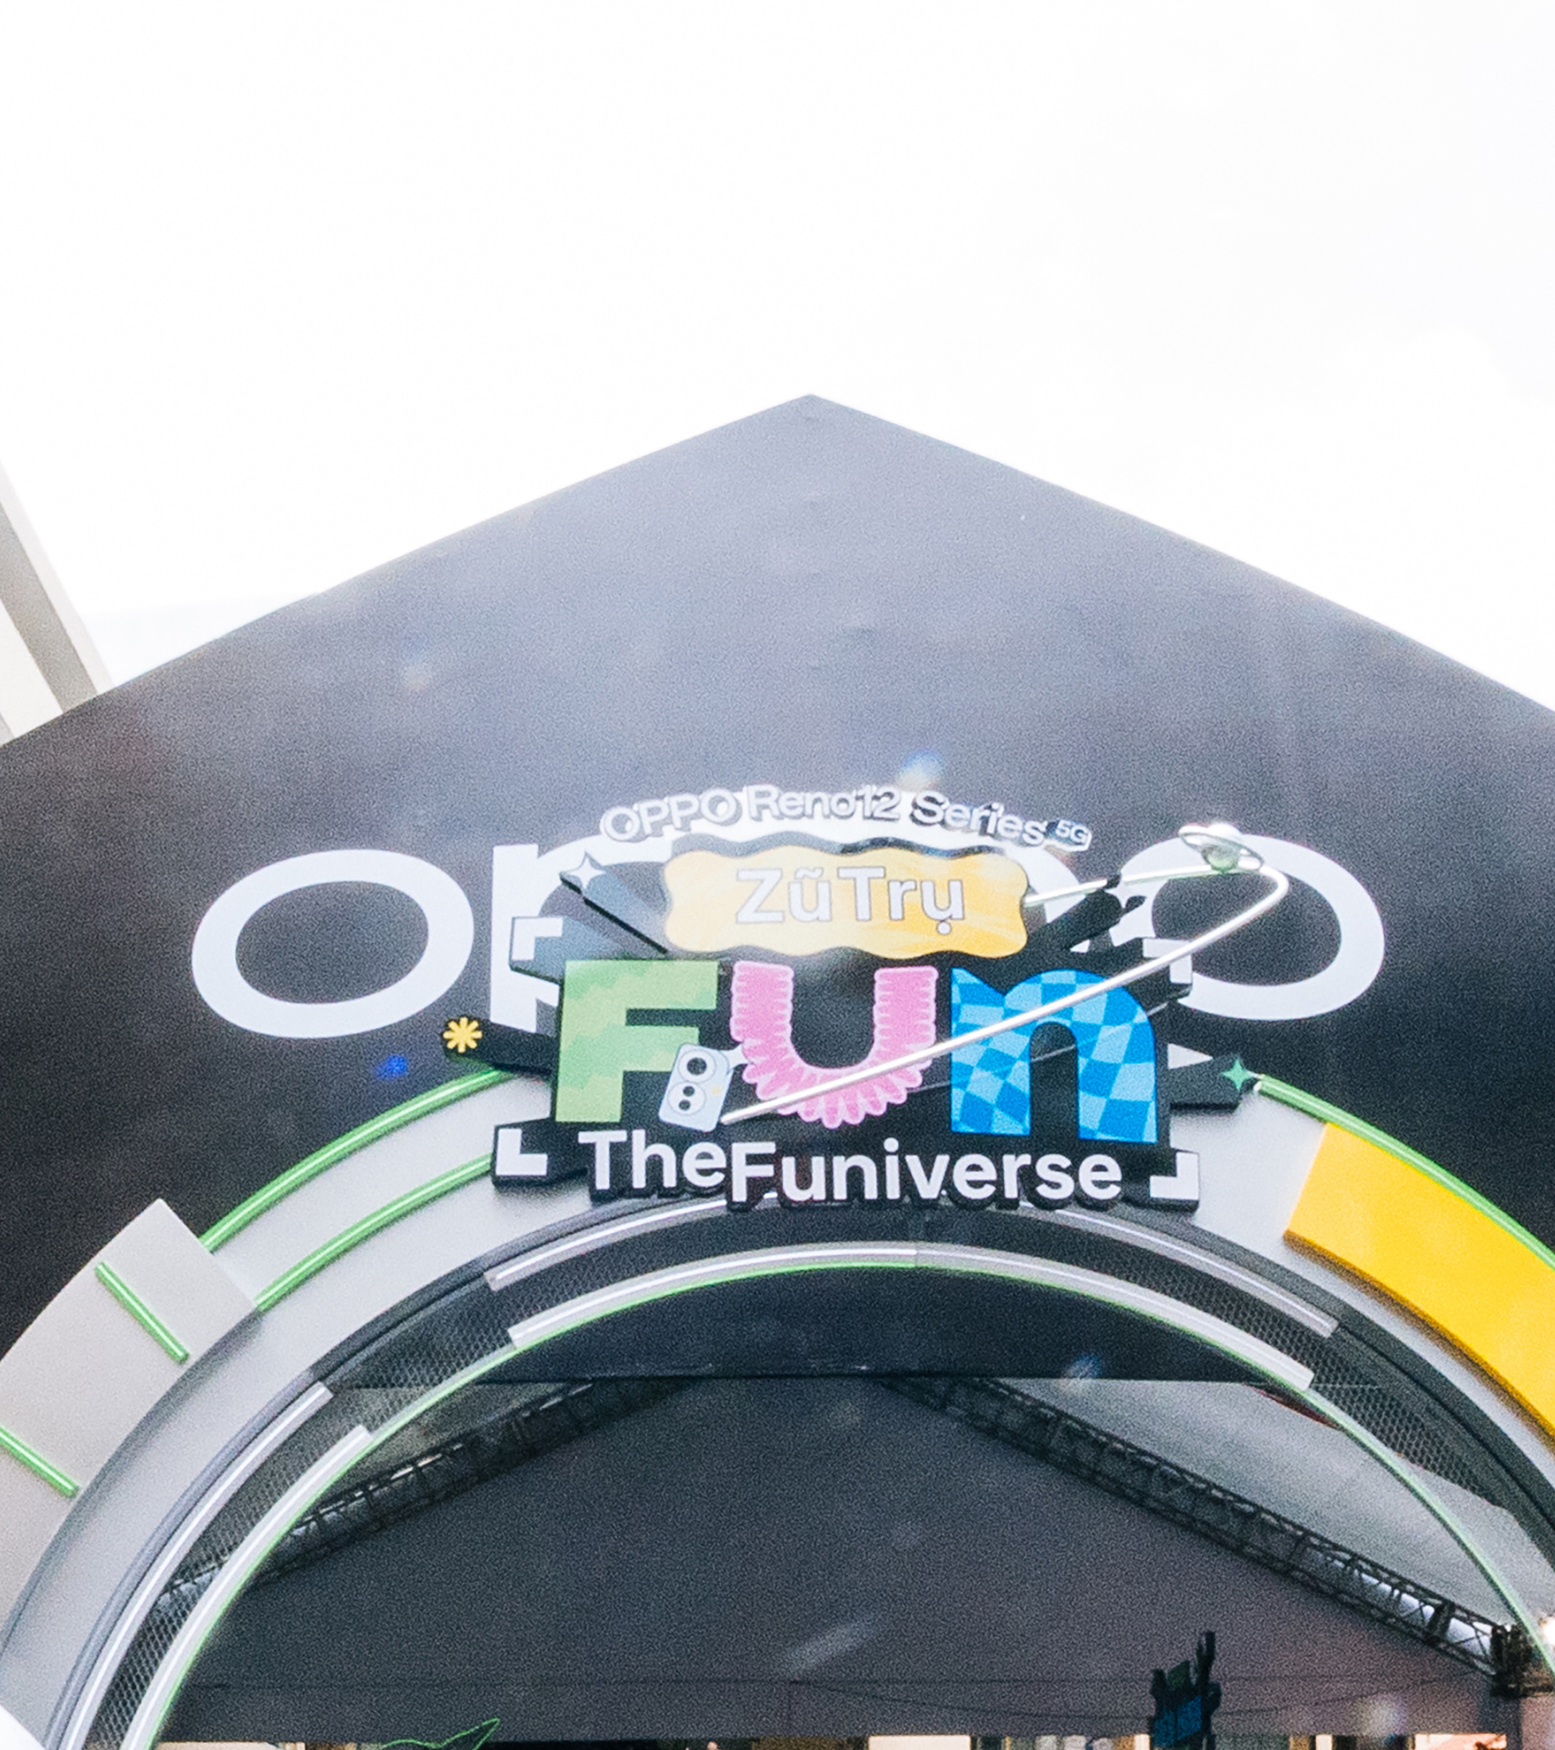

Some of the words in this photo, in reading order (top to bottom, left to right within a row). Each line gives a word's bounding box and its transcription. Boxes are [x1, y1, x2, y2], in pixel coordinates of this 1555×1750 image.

[600, 786, 746, 842] OPPO
[747, 783, 902, 823] Reno12
[908, 790, 1048, 847] Series
[1052, 817, 1092, 852] 5G
